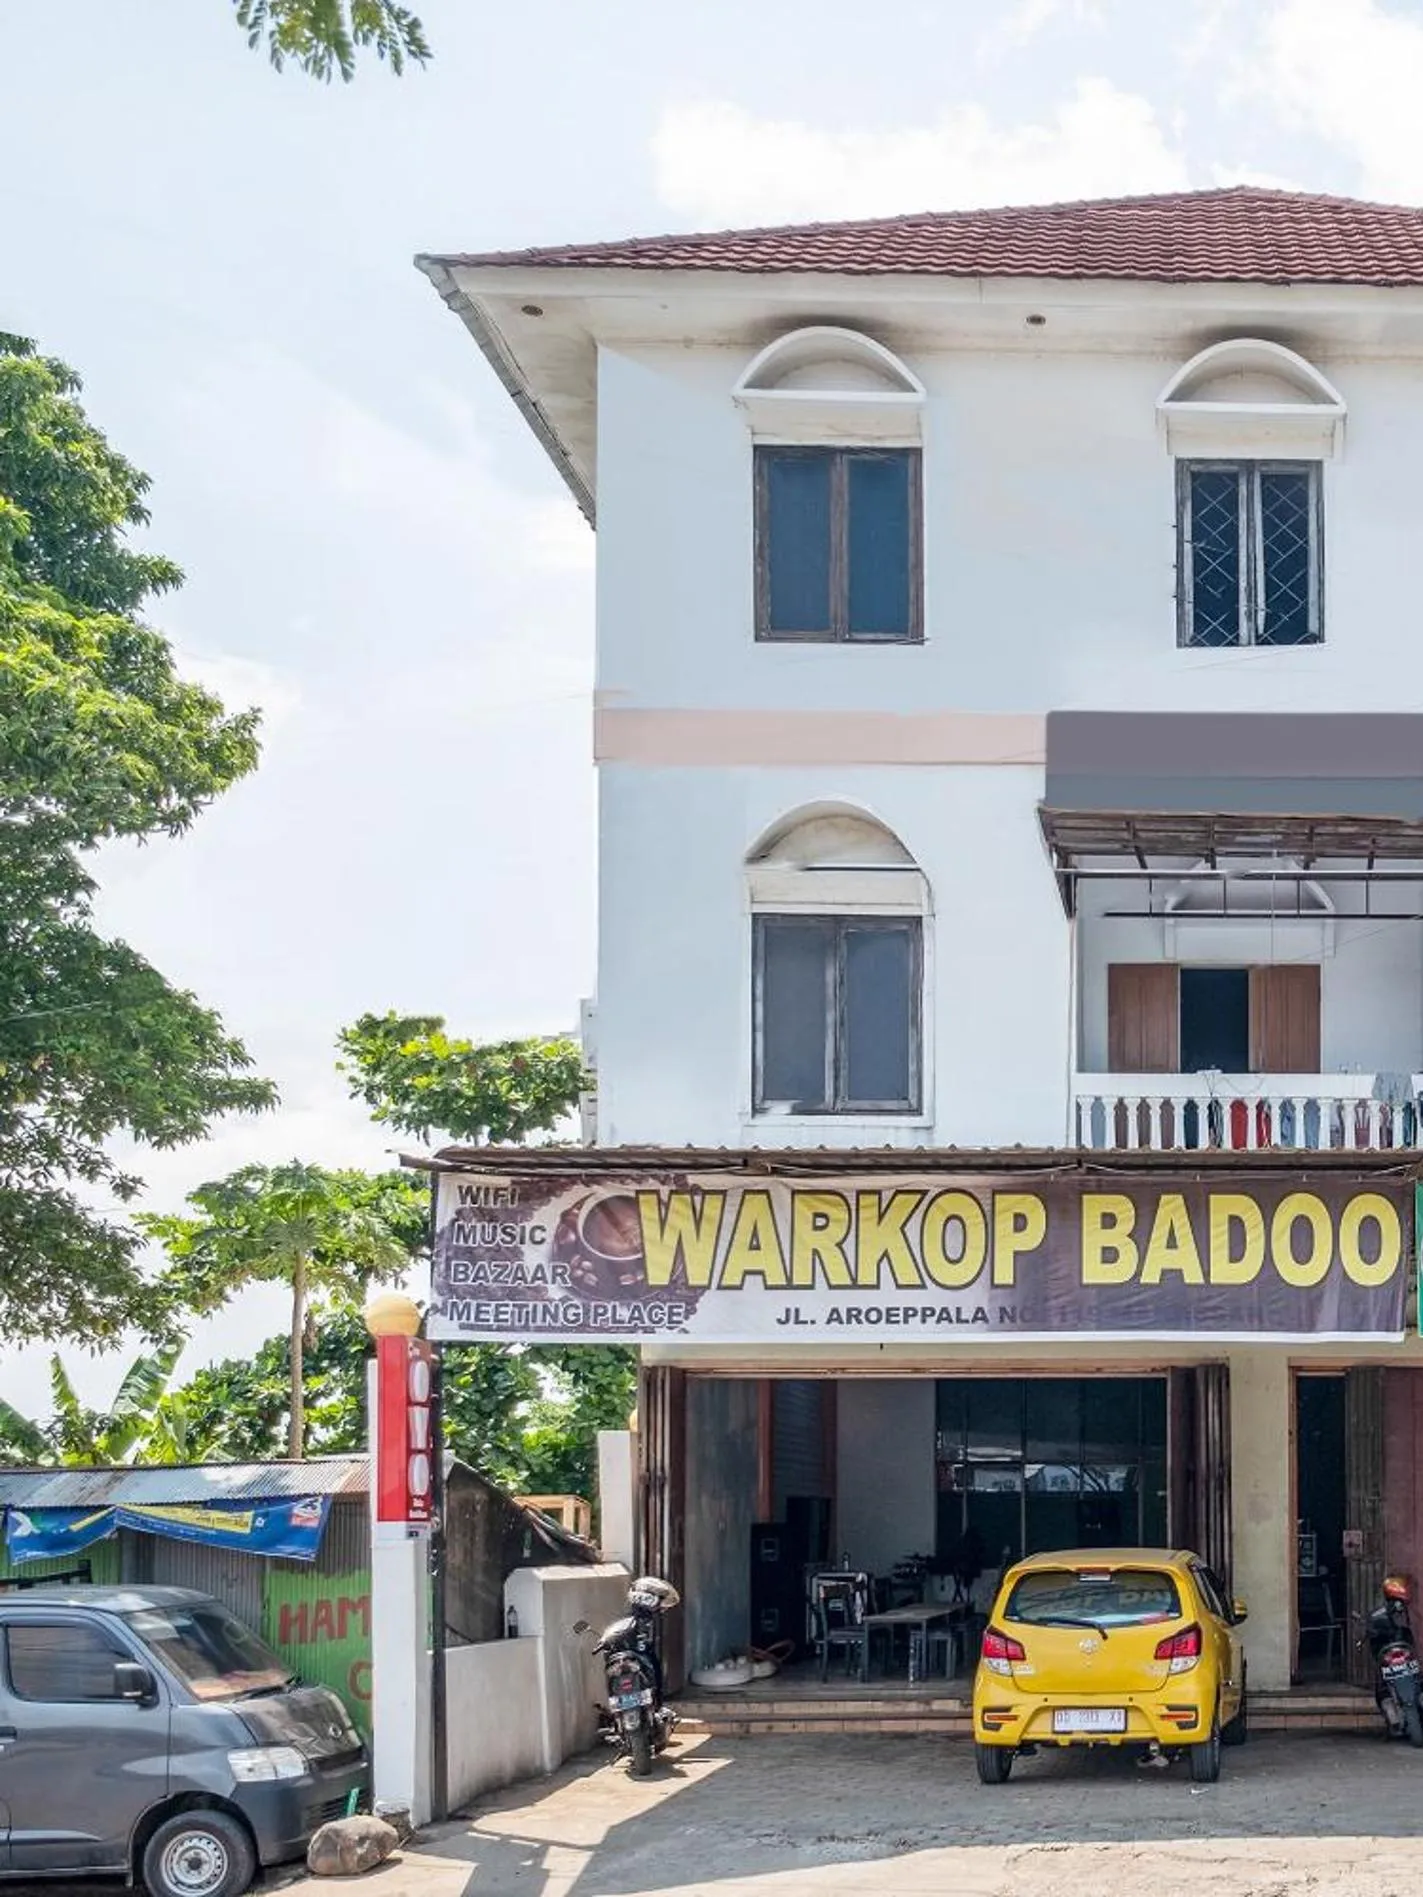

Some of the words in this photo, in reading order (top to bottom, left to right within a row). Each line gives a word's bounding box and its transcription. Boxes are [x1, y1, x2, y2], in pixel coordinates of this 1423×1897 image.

[457, 1185, 520, 1206] WIFI
[454, 1223, 547, 1246] MUSIC
[636, 1188, 1047, 1291] WARKOP
[1080, 1191, 1402, 1288] BADOO
[452, 1262, 571, 1286] BAZAAR
[449, 1300, 583, 1327] MEETING
[591, 1302, 684, 1327] PLACE
[776, 1307, 816, 1326] JL.
[825, 1305, 988, 1326] AROEPPALA
